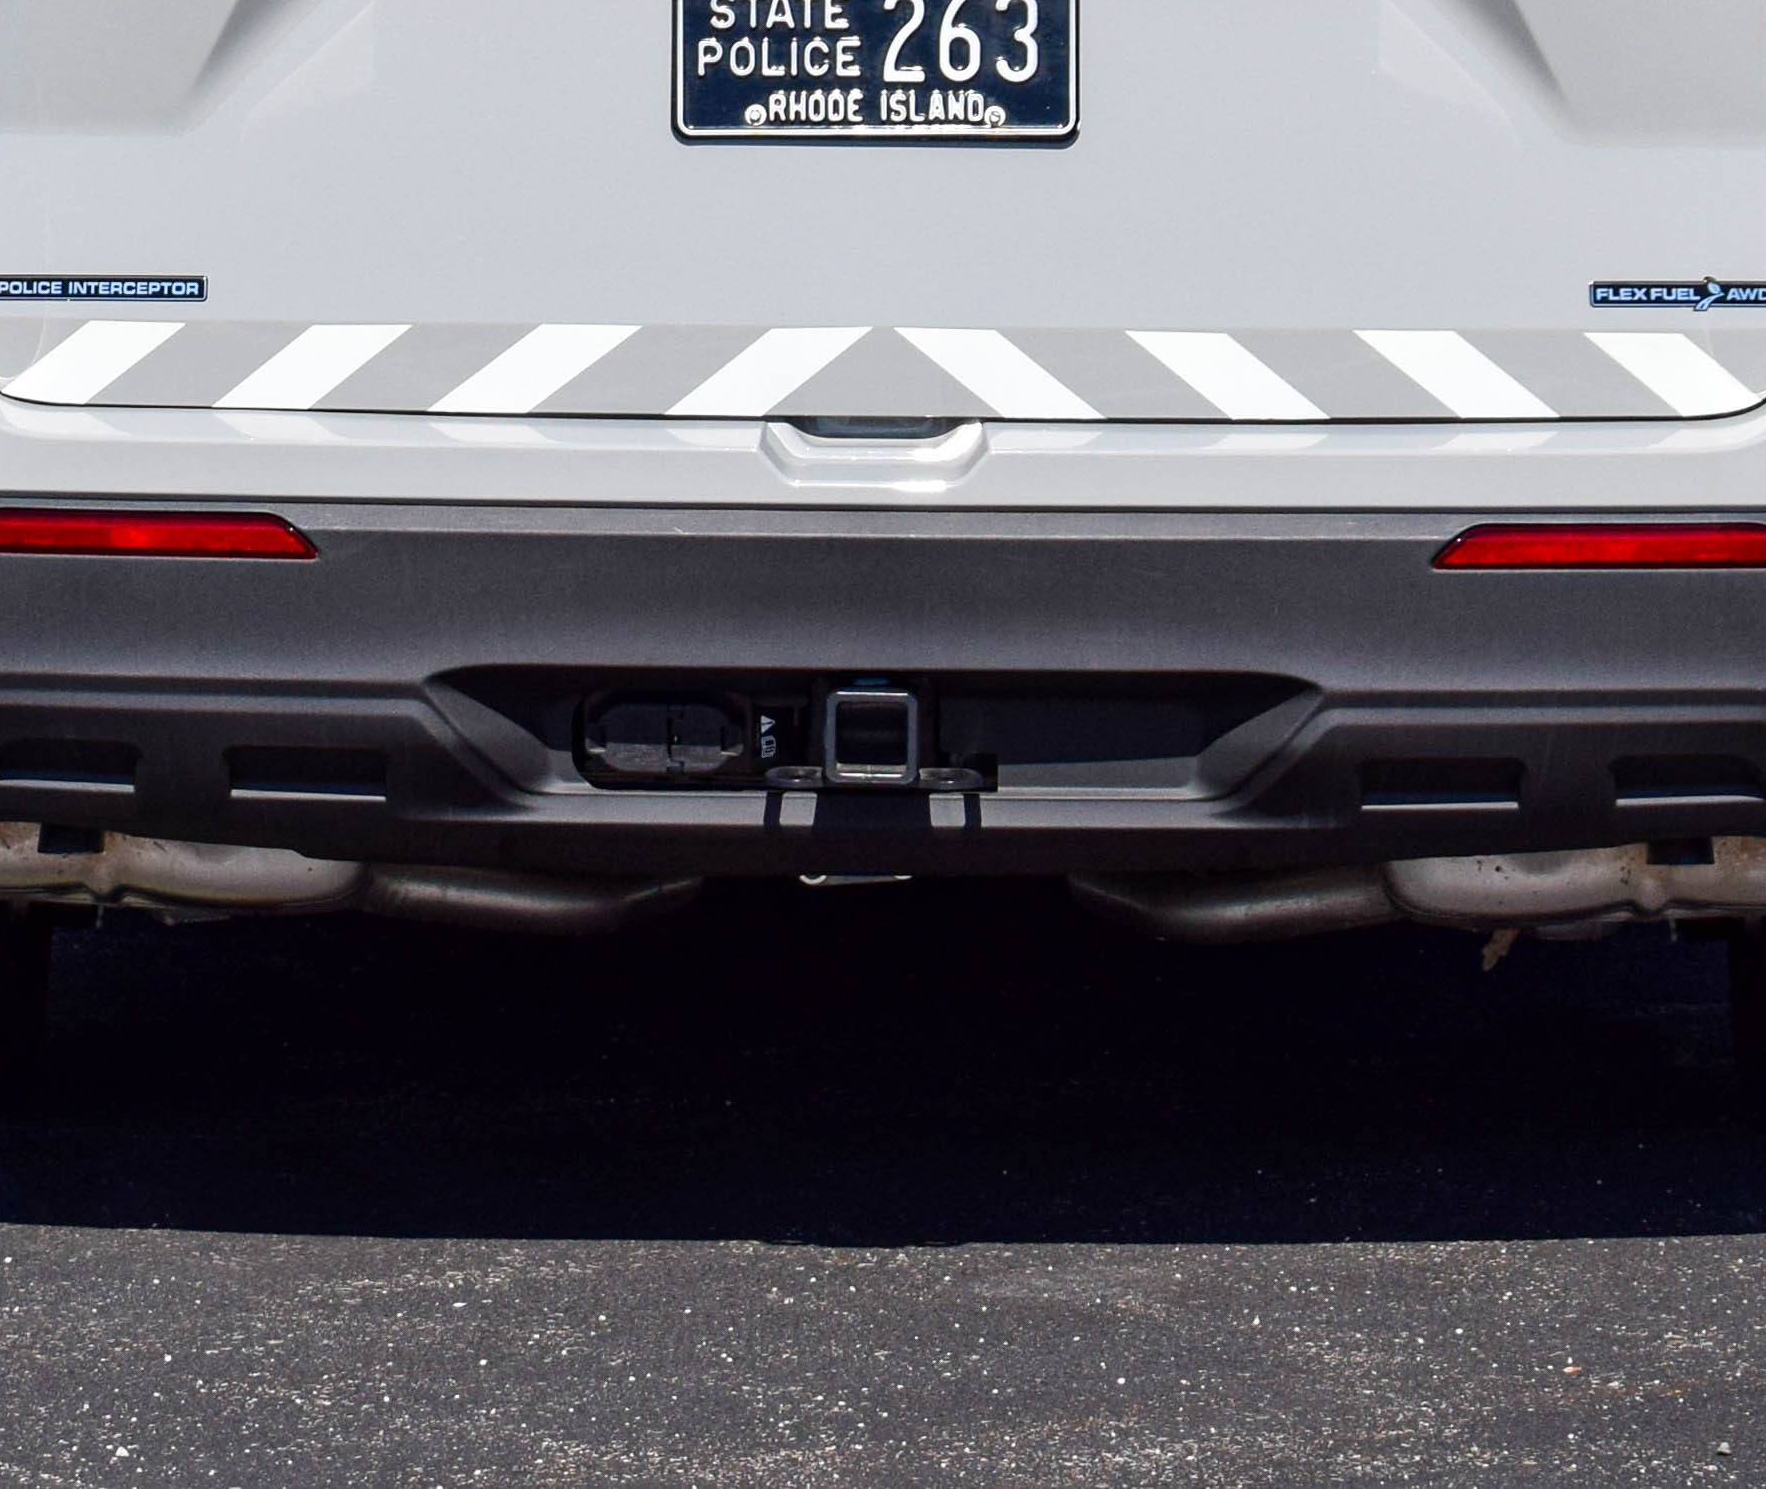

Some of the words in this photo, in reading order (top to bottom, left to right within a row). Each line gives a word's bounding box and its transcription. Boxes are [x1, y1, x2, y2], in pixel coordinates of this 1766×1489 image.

[697, 35, 862, 77] POLICE
[768, 89, 864, 122] RHODE
[880, 89, 985, 122] ISLAND
[68, 281, 200, 296] INTERCEPTOR
[1596, 287, 1648, 301] FLEX
[1650, 288, 1701, 301] FUEL
